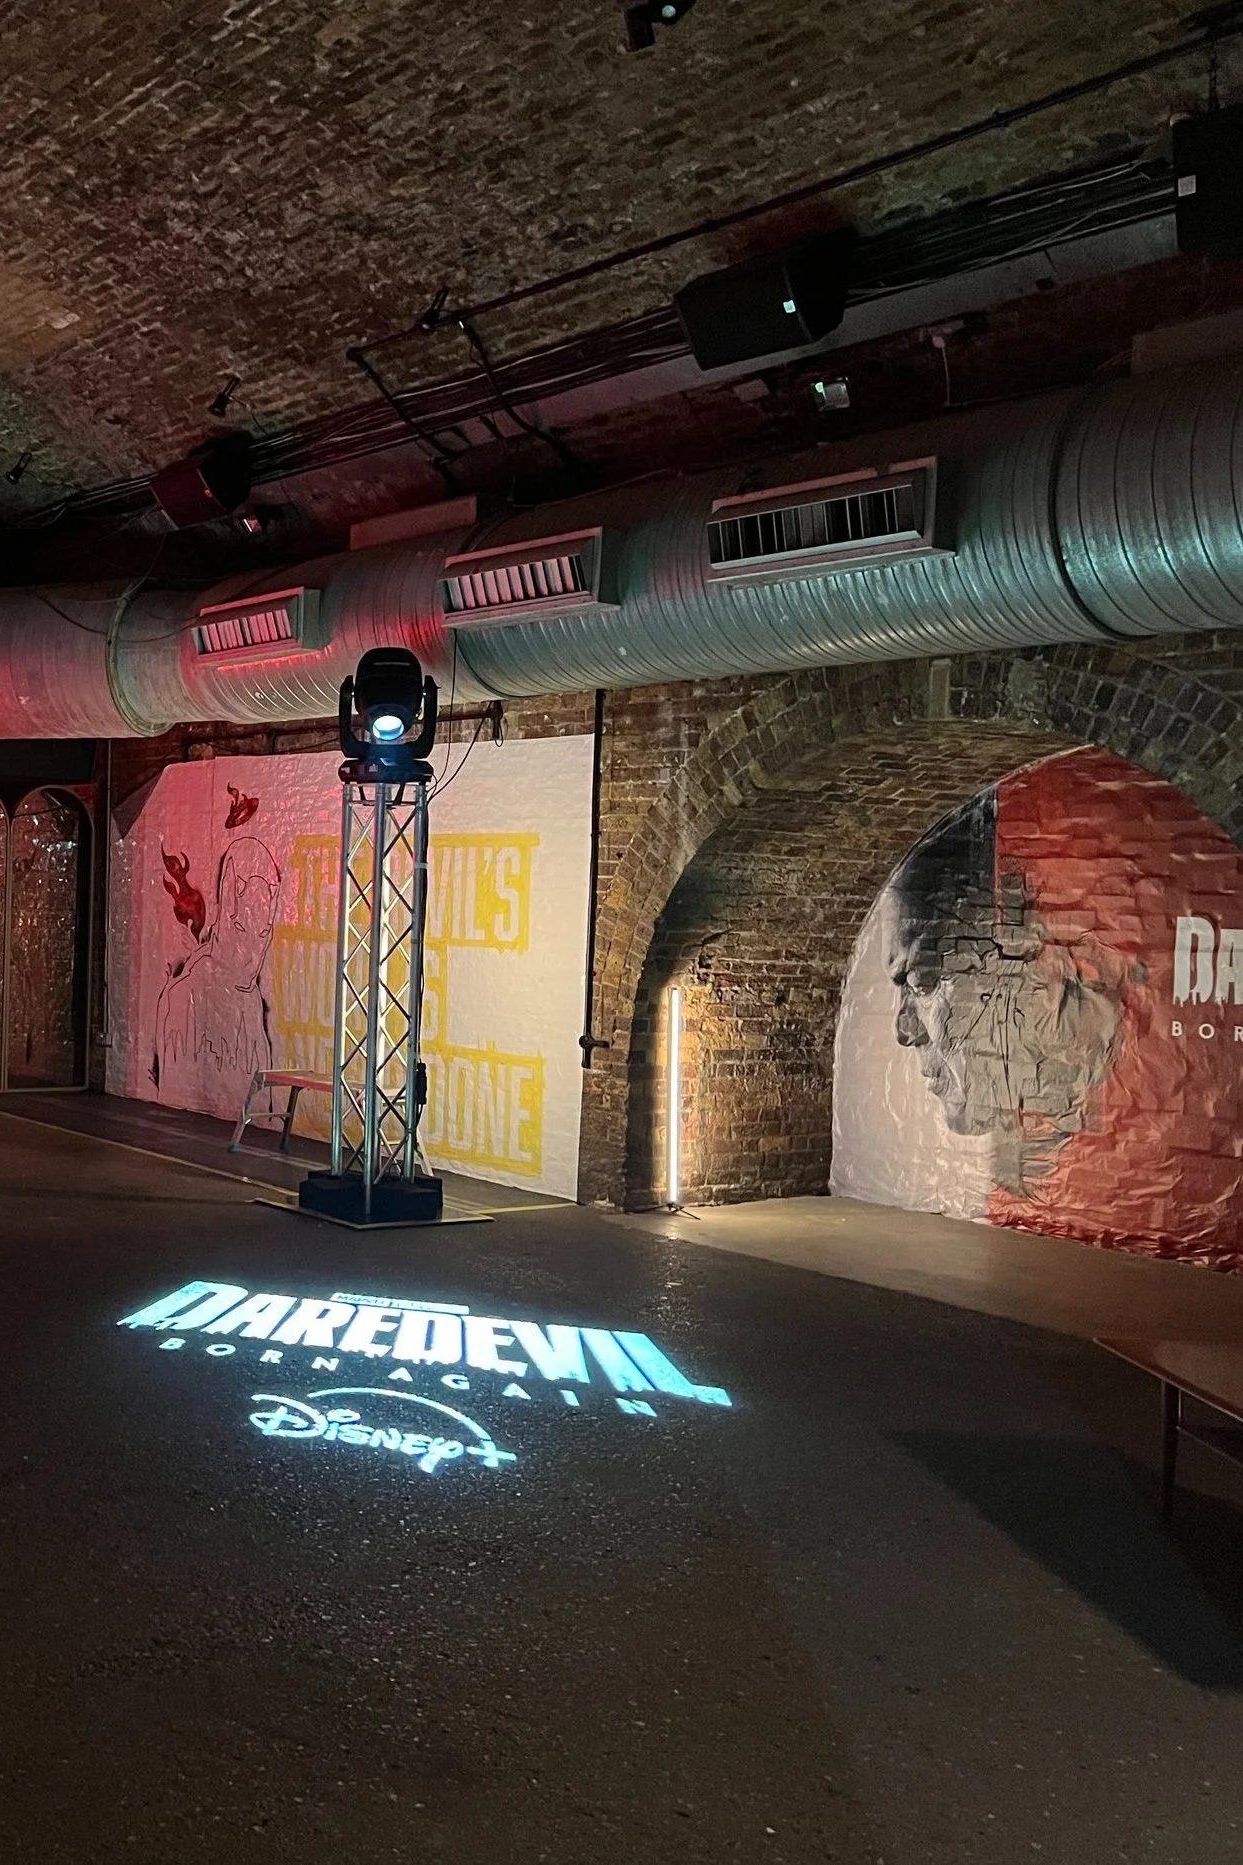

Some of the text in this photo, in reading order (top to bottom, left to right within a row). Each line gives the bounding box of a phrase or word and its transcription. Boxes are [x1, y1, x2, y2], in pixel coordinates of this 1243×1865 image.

[389, 845, 521, 942] DVIL'S
[421, 1053, 533, 1162] DONE
[116, 1280, 733, 1407] DAREDEVIL
[159, 1336, 658, 1418] BORN AGAIN
